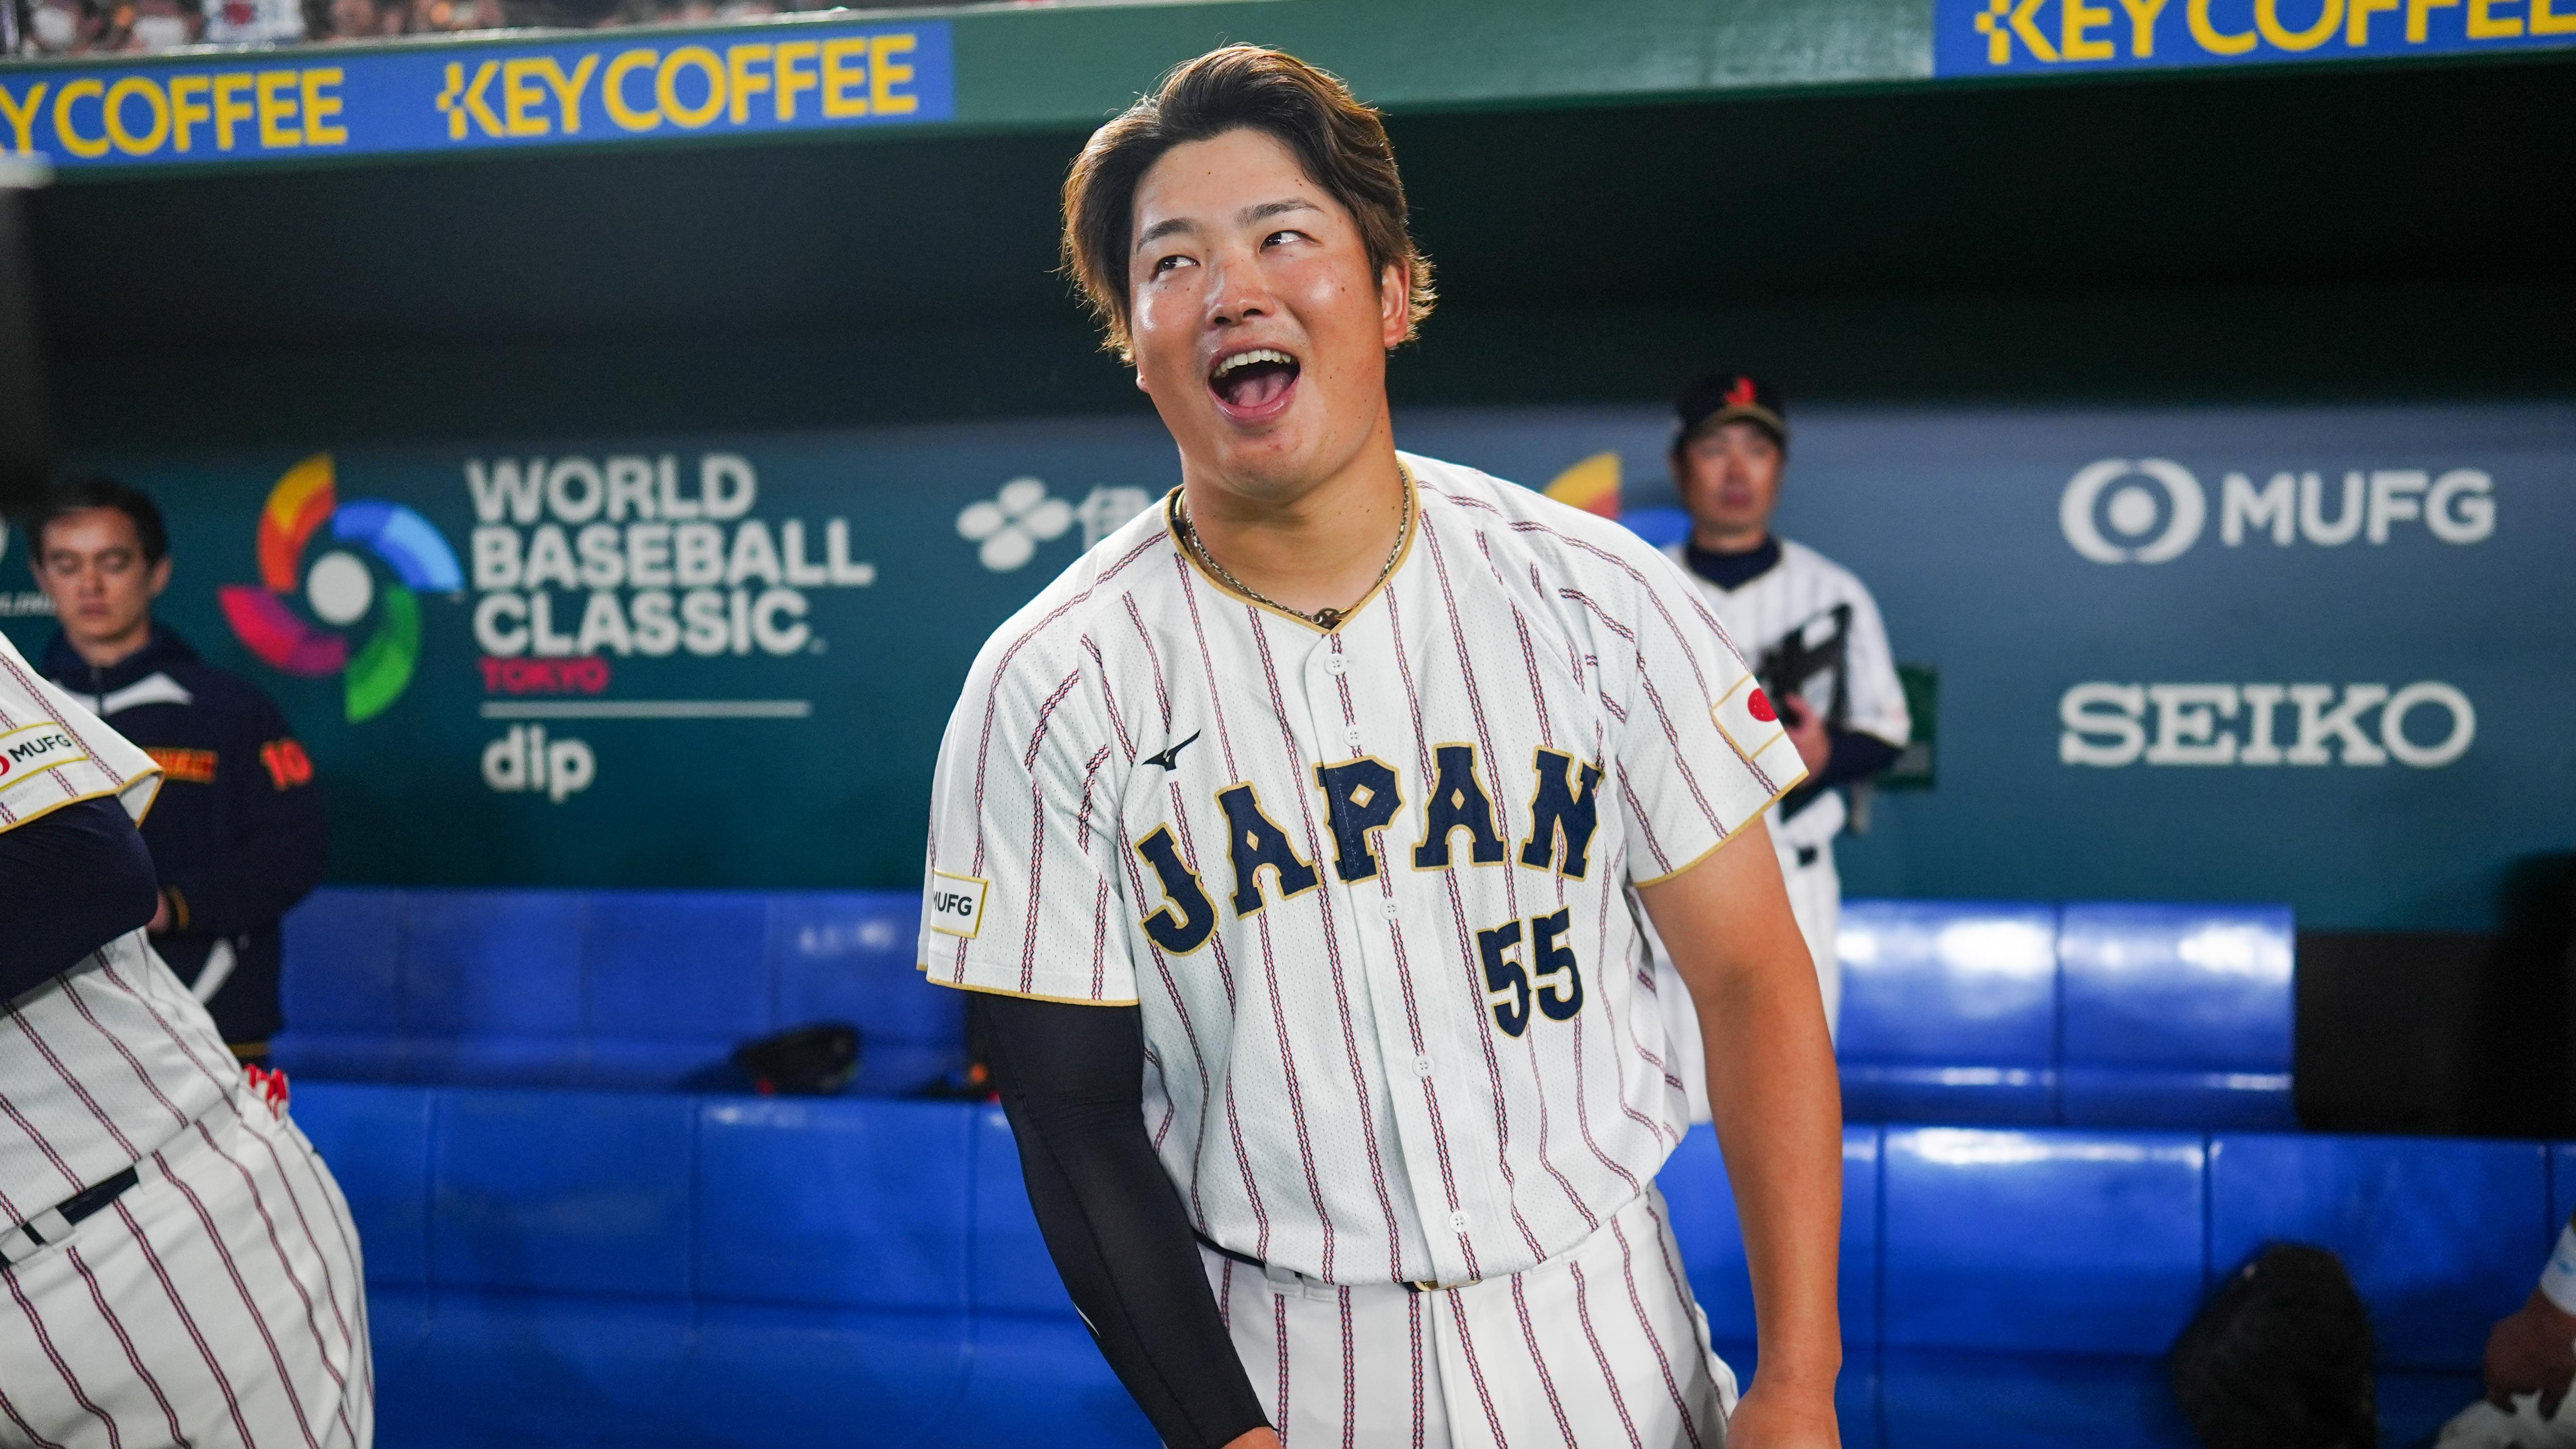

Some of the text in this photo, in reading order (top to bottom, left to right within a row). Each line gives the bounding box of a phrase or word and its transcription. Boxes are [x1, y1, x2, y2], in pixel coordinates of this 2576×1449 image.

[466, 453, 757, 524] WORLD
[2221, 468, 2496, 547] MUFG
[472, 519, 875, 589] BASEBALL
[474, 589, 811, 656] CLASSIC
[478, 656, 609, 693] TOKYO
[8, 733, 72, 763] MUFG
[2059, 681, 2476, 768] SEIKO
[260, 740, 313, 790] 10
[481, 724, 596, 803] dip
[1134, 742, 1605, 956] JAPAN
[1476, 905, 1584, 1039] 55
